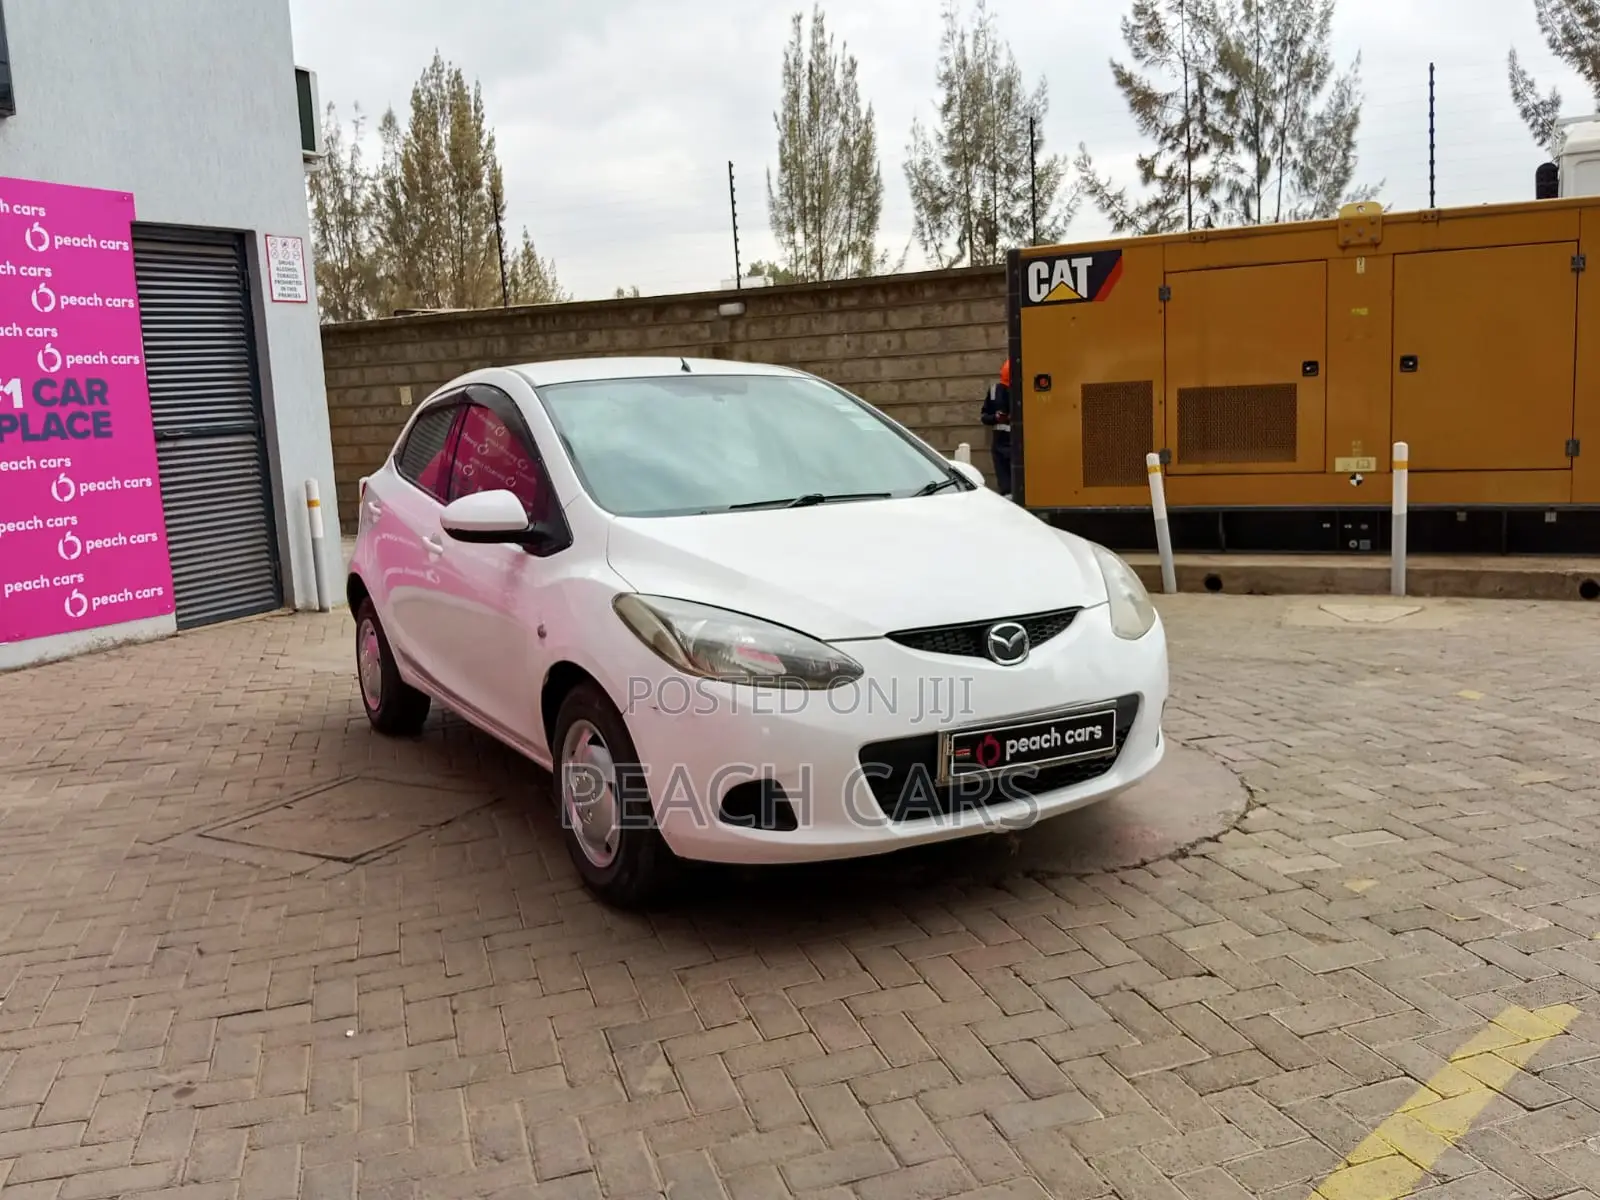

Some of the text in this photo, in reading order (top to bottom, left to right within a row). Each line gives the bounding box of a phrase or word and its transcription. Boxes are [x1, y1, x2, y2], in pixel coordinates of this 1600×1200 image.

[12, 204, 46, 217] cars
[54, 234, 130, 251] peach cars
[19, 265, 53, 278] cars
[1028, 257, 1093, 303] CAT
[60, 293, 135, 309] peach cars
[25, 327, 58, 338] cars
[66, 351, 140, 369] peach cars
[32, 377, 109, 408] CAR
[39, 457, 72, 469] cars
[79, 476, 153, 497] peach cars
[0, 515, 78, 538] peach cars
[86, 531, 158, 554] peach cars
[4, 573, 85, 598] peach cars
[91, 586, 164, 611] peach cars
[1005, 724, 1103, 761] peach cars
